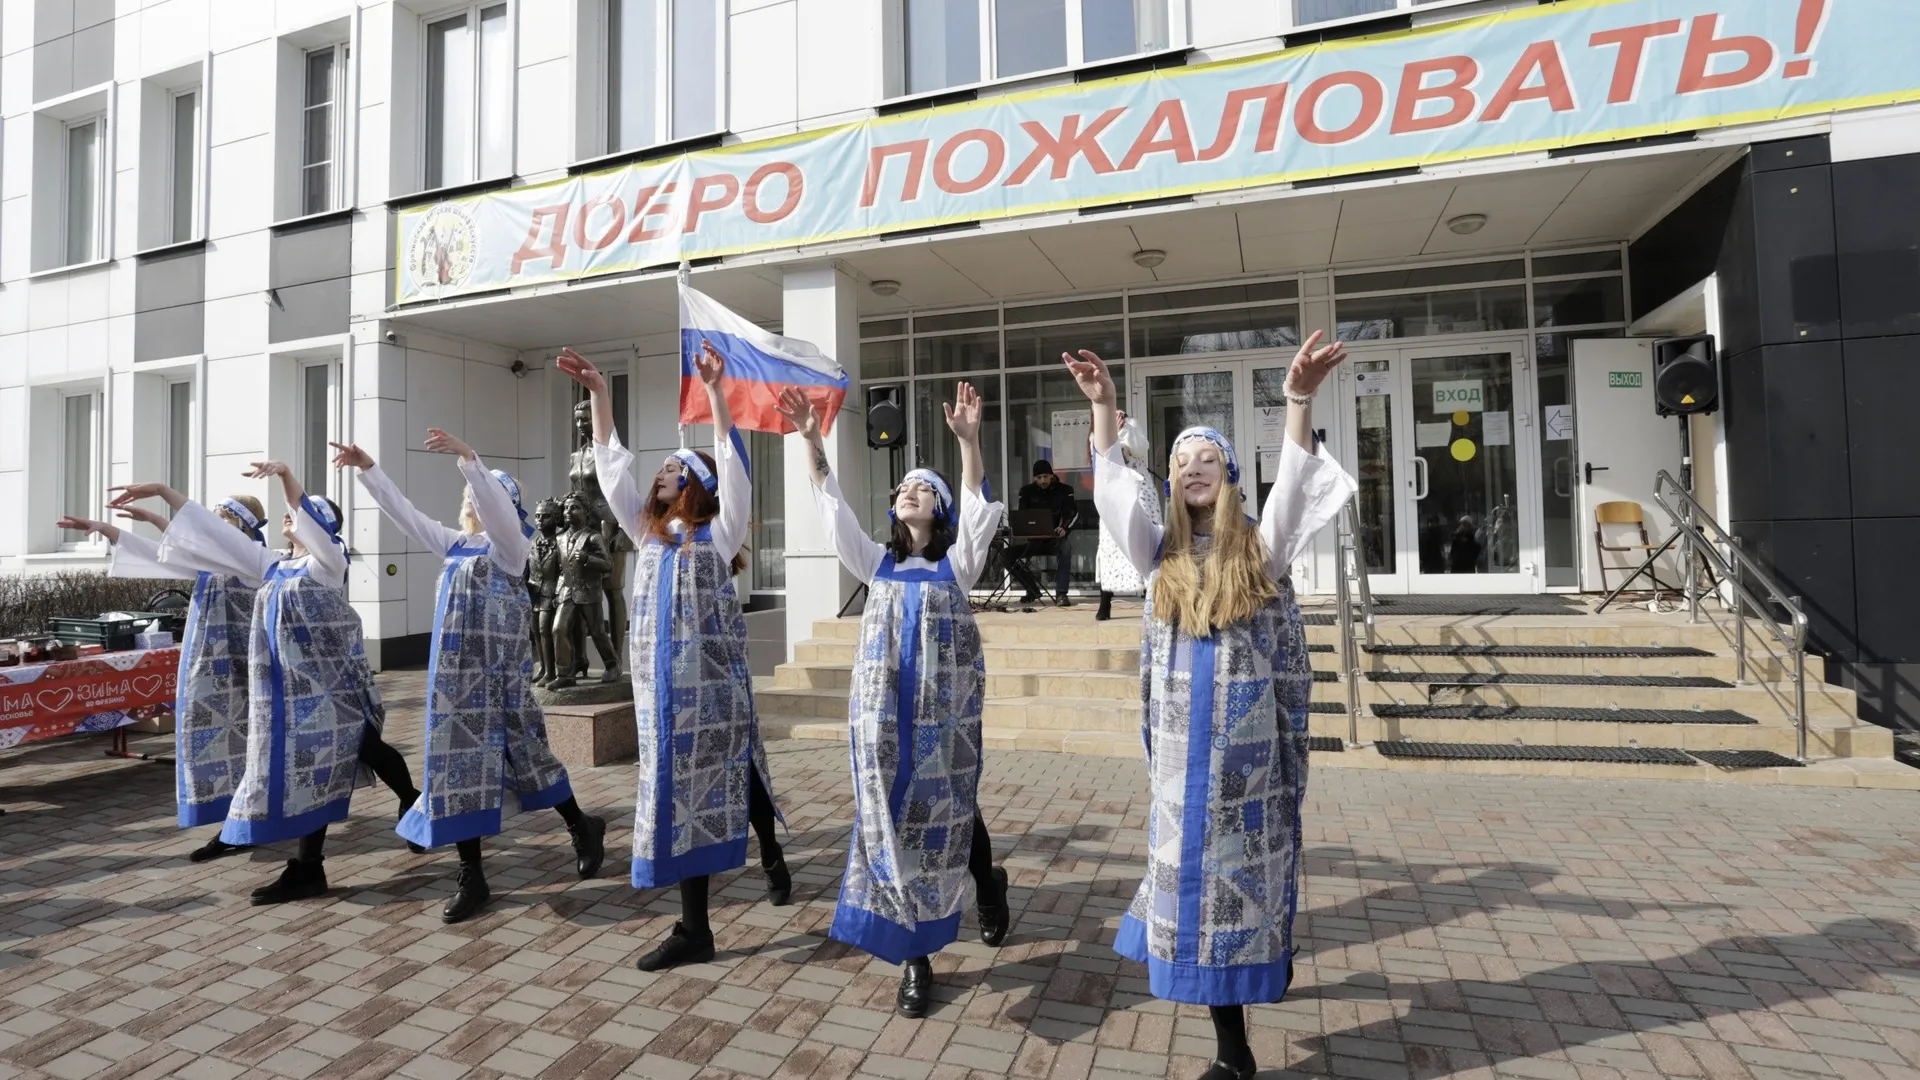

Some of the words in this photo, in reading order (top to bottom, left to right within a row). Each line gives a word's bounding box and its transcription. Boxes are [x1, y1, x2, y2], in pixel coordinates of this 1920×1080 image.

[510, 160, 804, 275] ДОБРО
[859, 0, 1826, 208] ПОЖАЛОВАТЬ!
[1609, 373, 1642, 387] ВЫХОД
[1435, 388, 1481, 403] ВХОД
[77, 679, 131, 701] ЗИМА
